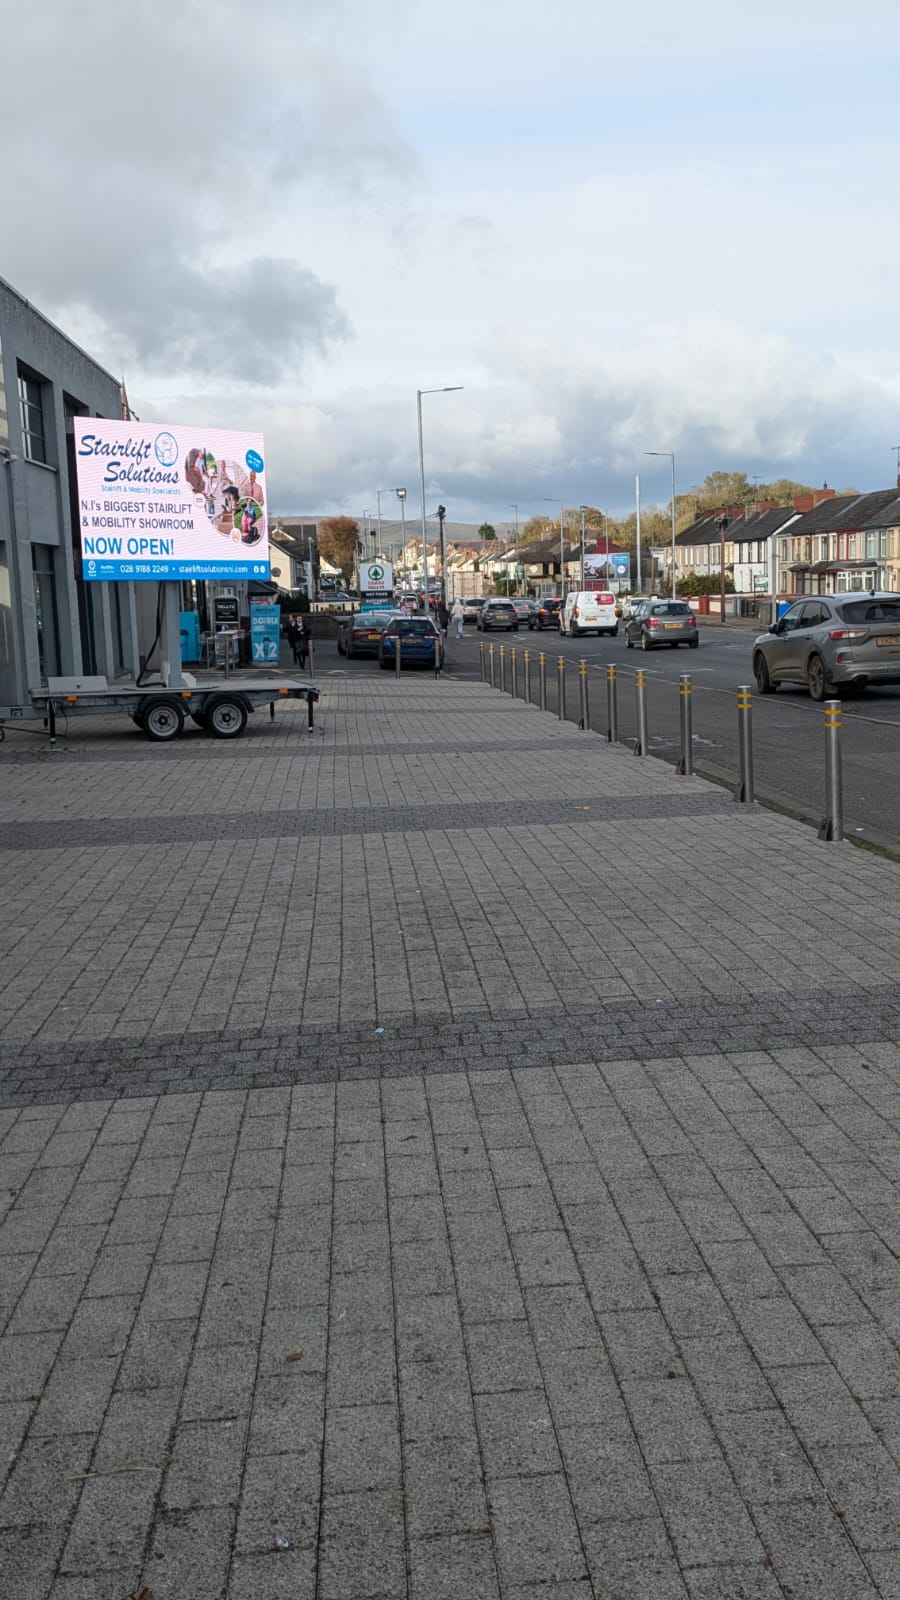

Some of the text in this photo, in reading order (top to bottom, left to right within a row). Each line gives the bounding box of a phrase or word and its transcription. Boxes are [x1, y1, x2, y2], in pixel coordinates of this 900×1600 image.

[78, 435, 152, 465] Stairlift
[104, 461, 180, 484] Solutions
[81, 500, 193, 514] N.I's BIGGEST STAIRLIFT
[82, 516, 194, 529] & MOBILITY SHOWROOM
[83, 537, 174, 555] NOW OPEN!
[120, 565, 134, 573] 028
[252, 617, 279, 625] DOUBLE
